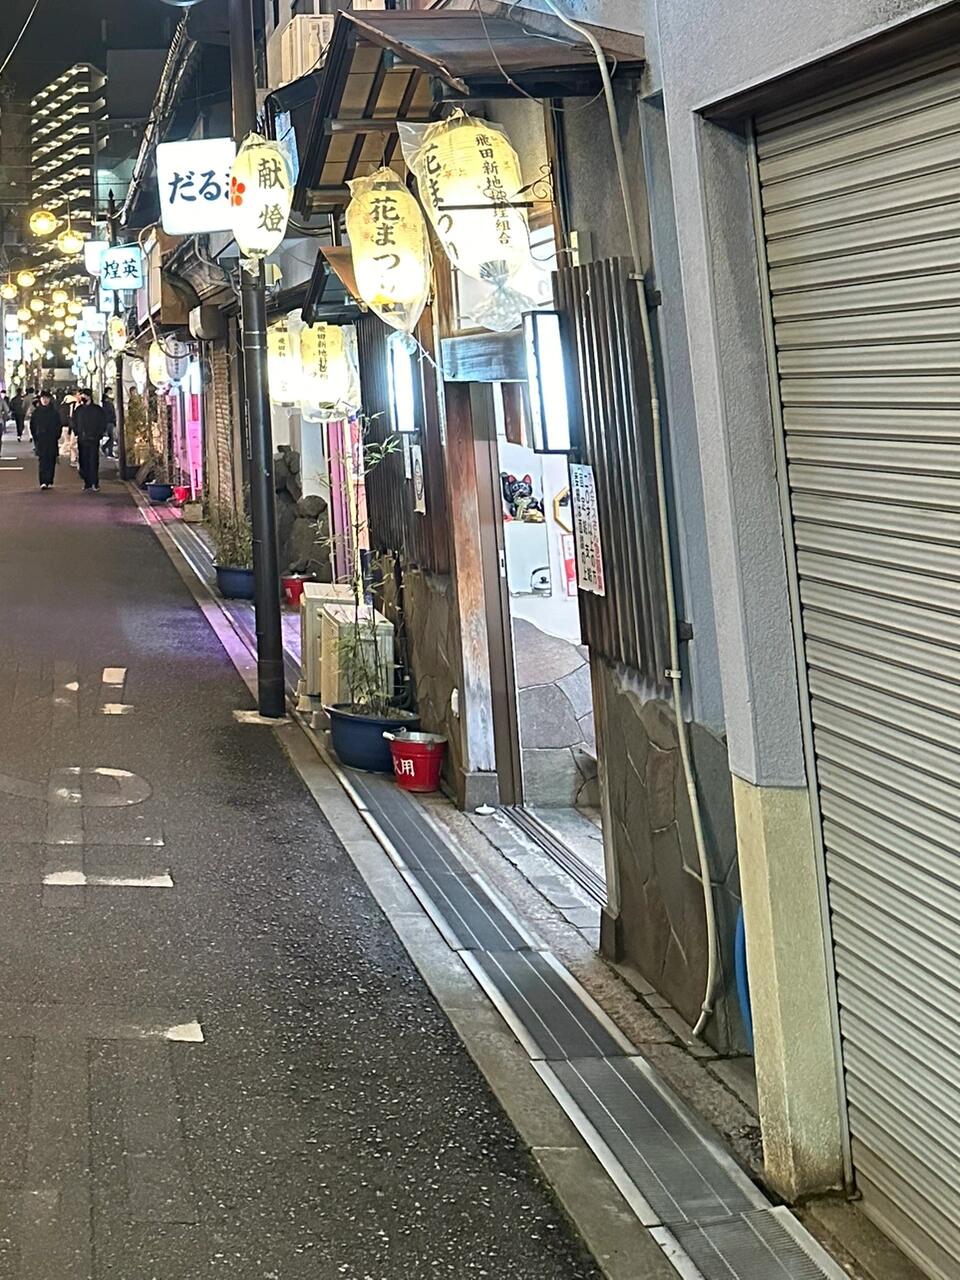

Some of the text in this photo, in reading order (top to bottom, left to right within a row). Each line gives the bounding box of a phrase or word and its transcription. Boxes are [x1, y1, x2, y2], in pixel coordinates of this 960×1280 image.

[168, 166, 232, 204] だる
[370, 196, 400, 294] 花まつ
